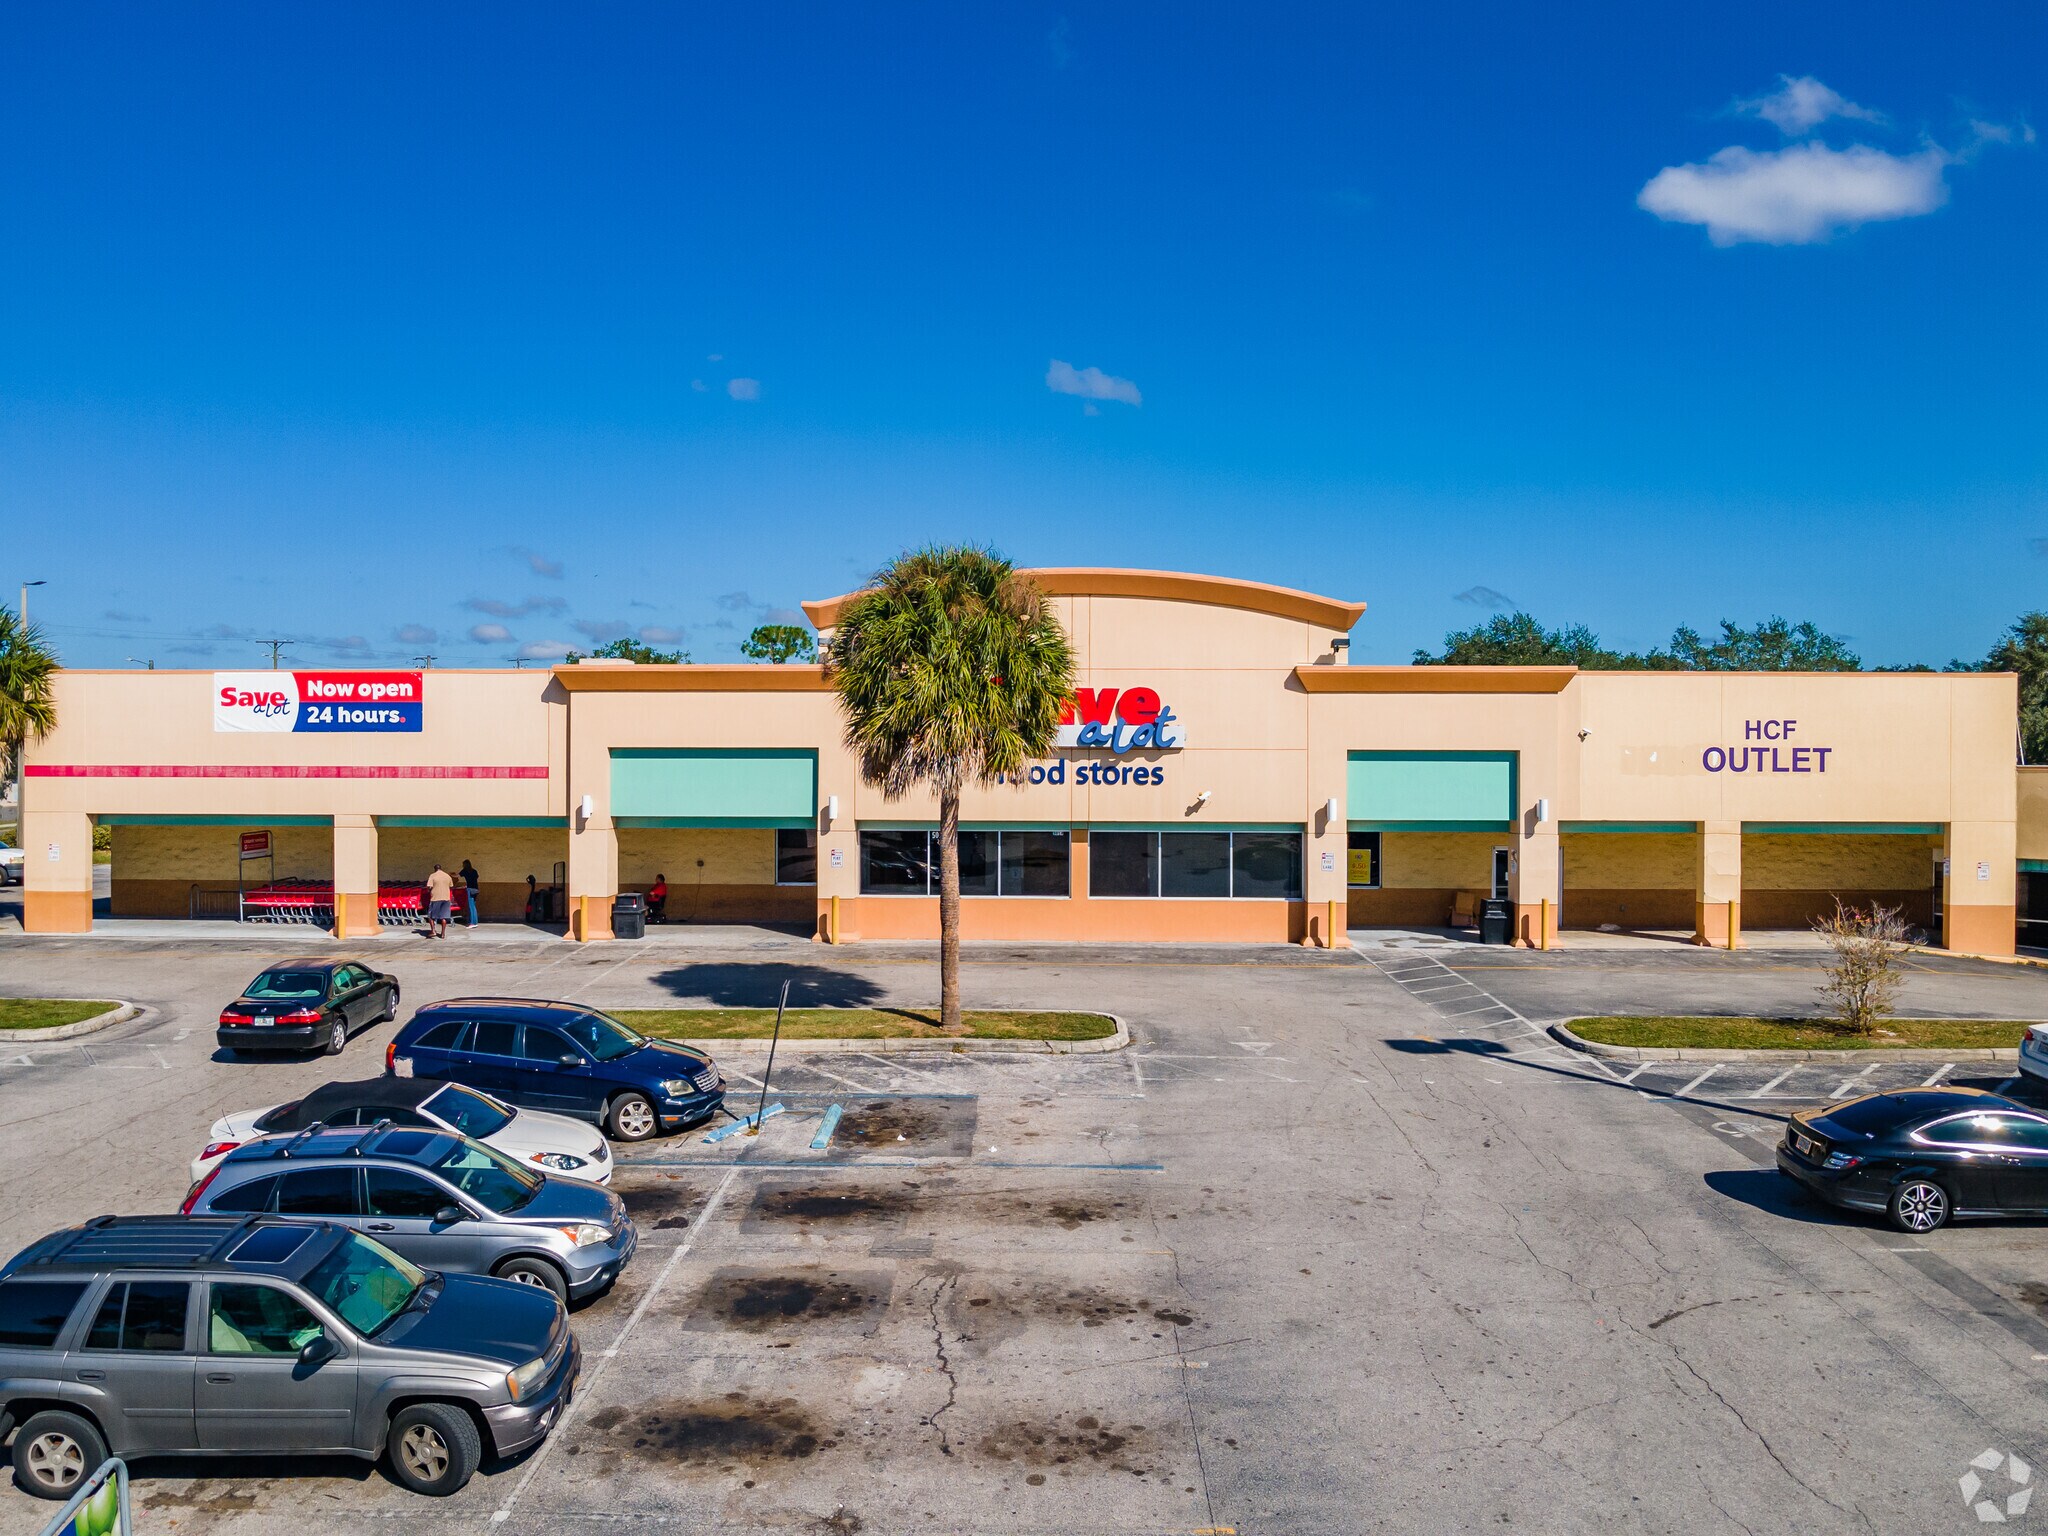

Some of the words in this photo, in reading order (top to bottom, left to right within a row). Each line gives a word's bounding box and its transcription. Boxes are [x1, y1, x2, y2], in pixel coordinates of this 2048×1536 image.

[220, 687, 286, 707] Save
[307, 680, 354, 697] Now
[357, 682, 413, 699] open
[307, 706, 333, 723] 24
[1058, 686, 1161, 726] ve
[1745, 719, 1798, 741] HCF
[1702, 746, 1833, 773] OUTLET
[1075, 762, 1165, 786] stores
